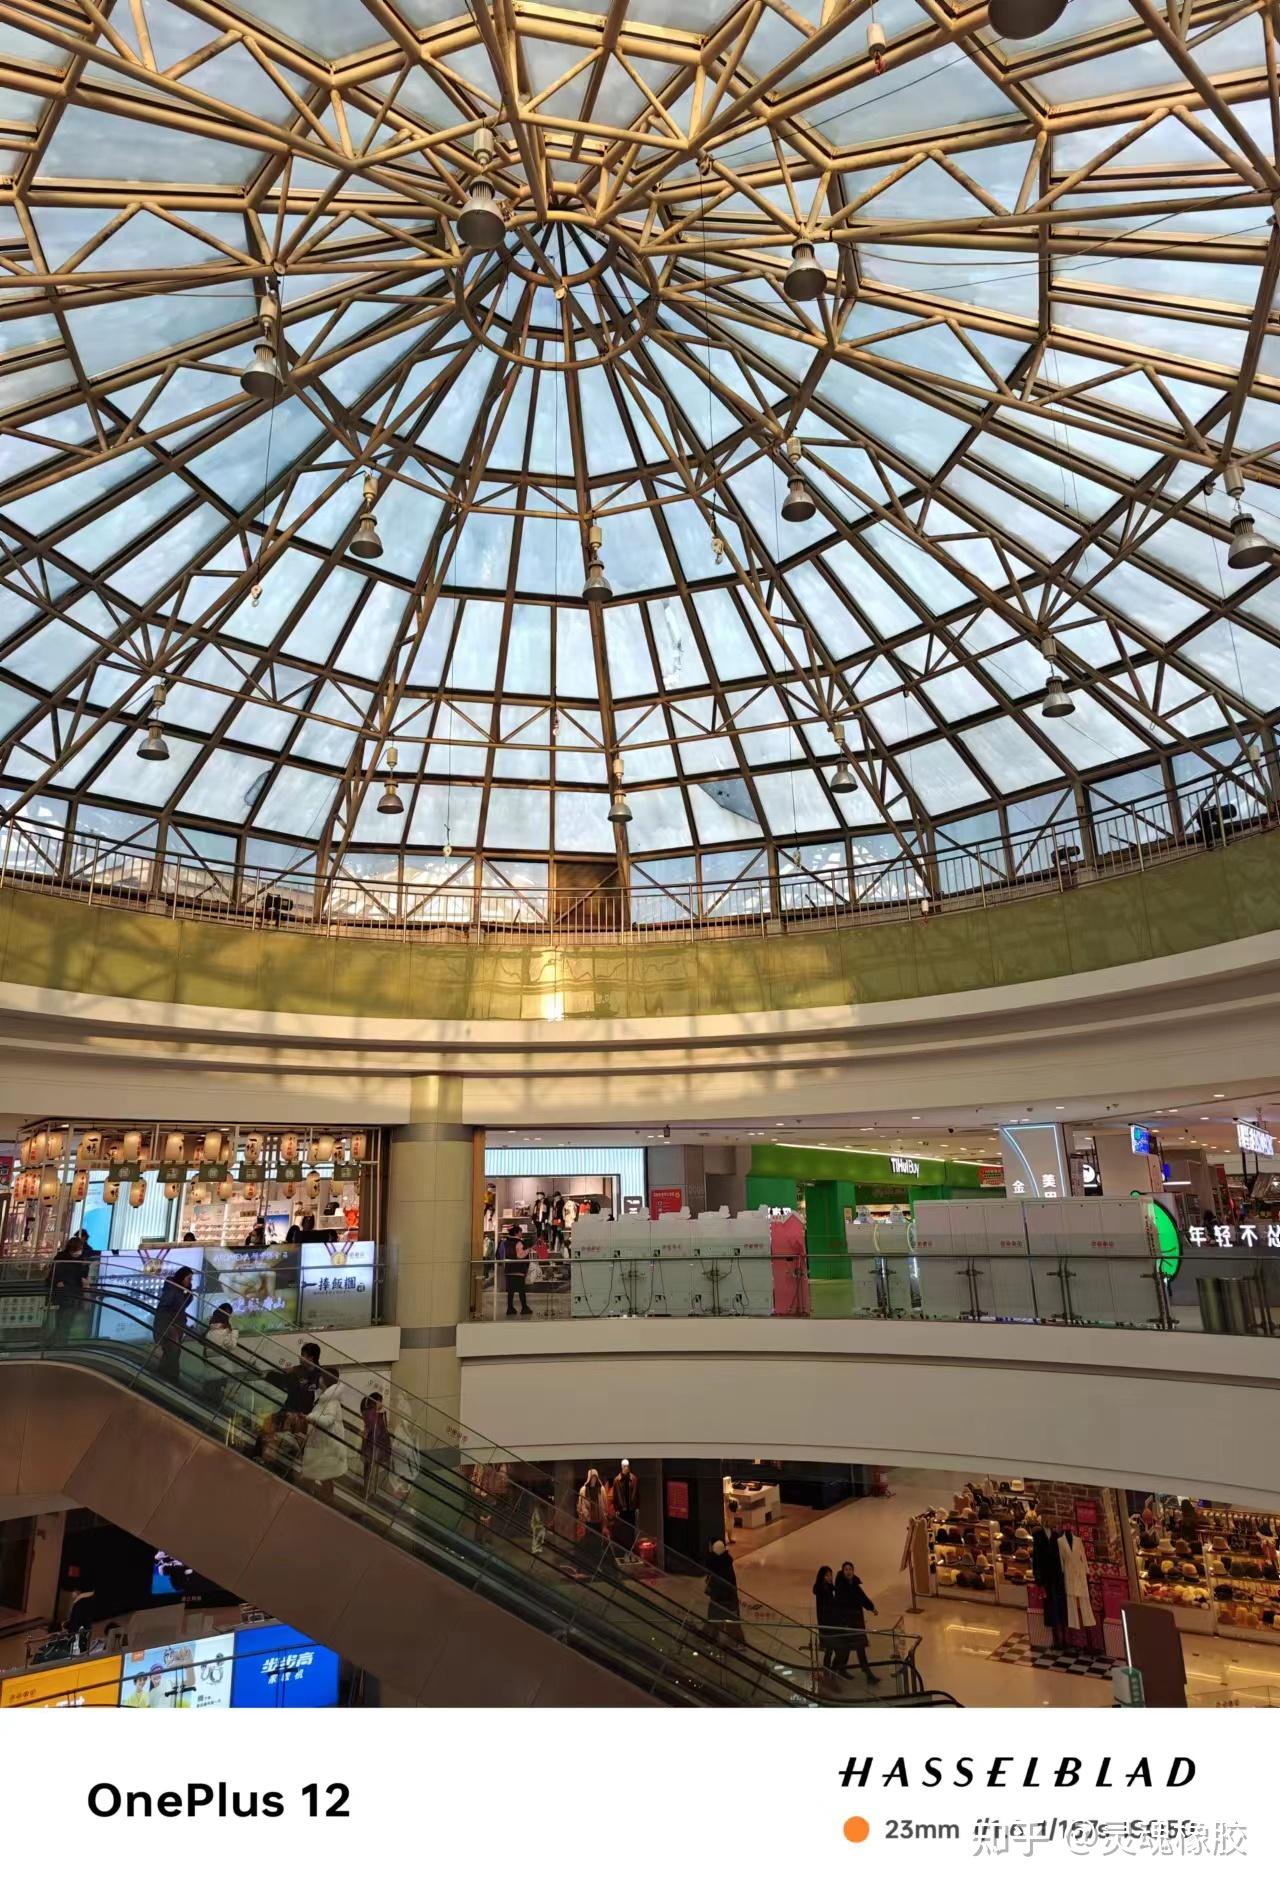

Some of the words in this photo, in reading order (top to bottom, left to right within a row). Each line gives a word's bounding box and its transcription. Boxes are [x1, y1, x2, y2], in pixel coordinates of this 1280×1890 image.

[1012, 1180, 1025, 1194] 金
[260, 1651, 315, 1674] 步步高
